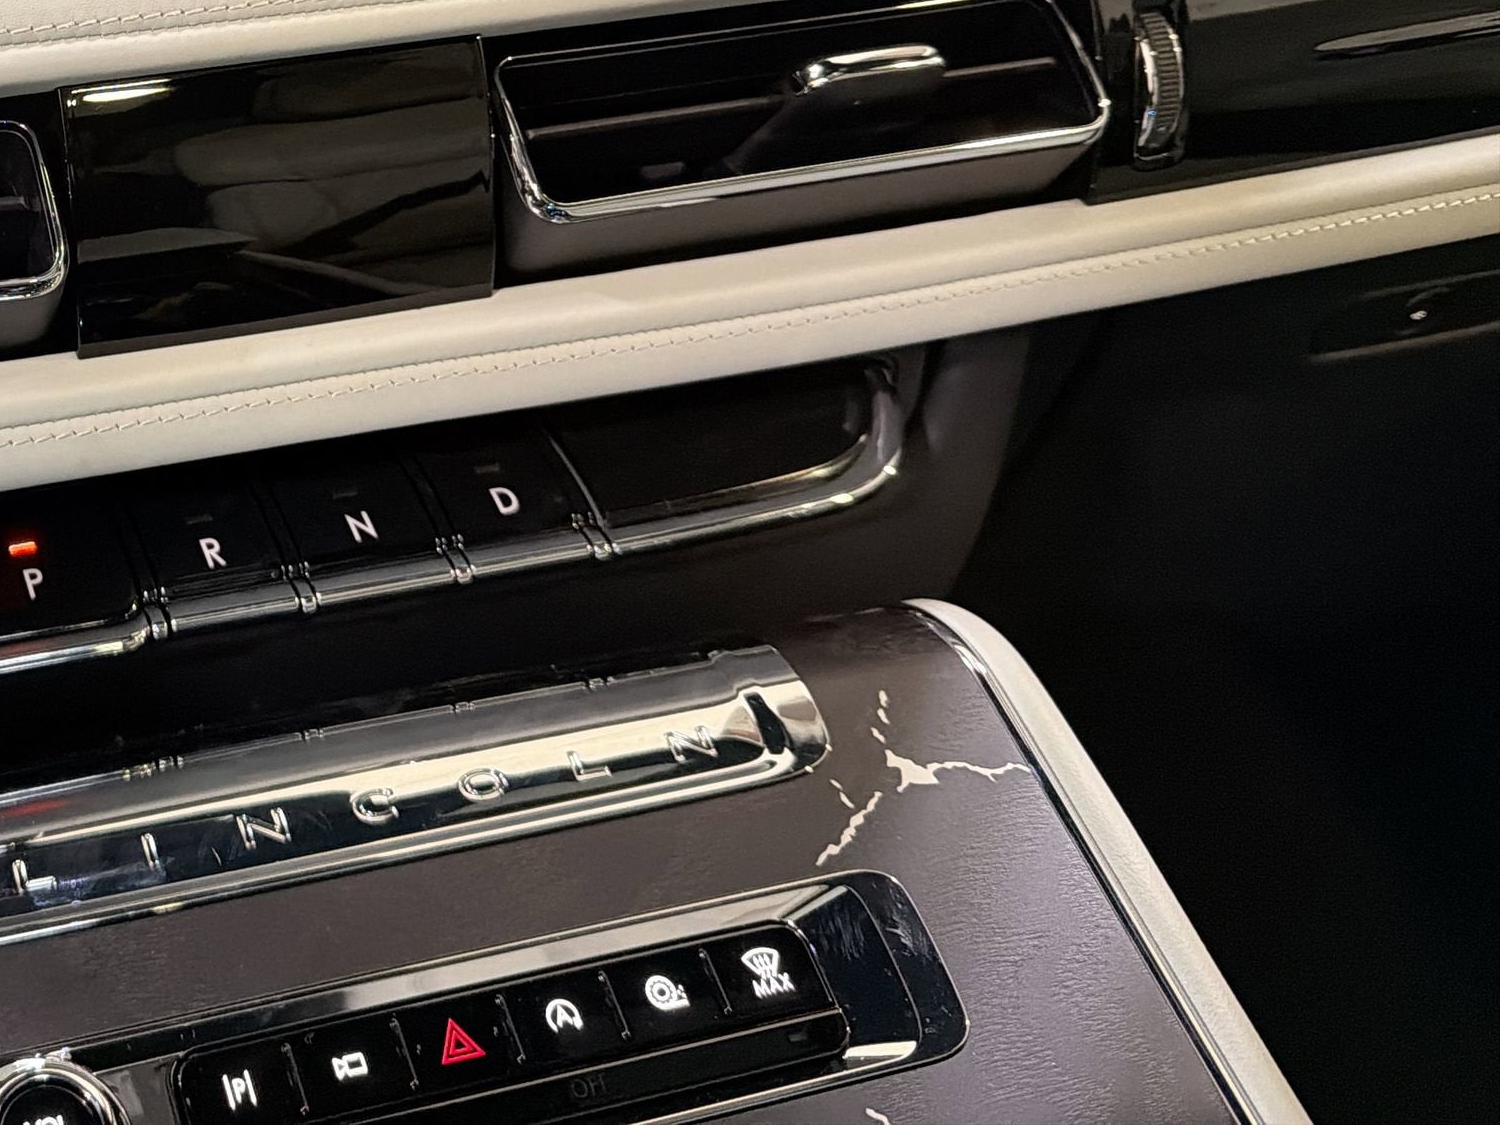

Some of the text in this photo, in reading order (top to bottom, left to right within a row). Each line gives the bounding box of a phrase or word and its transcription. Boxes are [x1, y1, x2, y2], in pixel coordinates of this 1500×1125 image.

[488, 486, 521, 516] D
[344, 510, 380, 544] N
[198, 536, 228, 570] R
[22, 567, 44, 601] P
[11, 724, 721, 896] LINCOLN
[751, 971, 797, 1000] MAX
